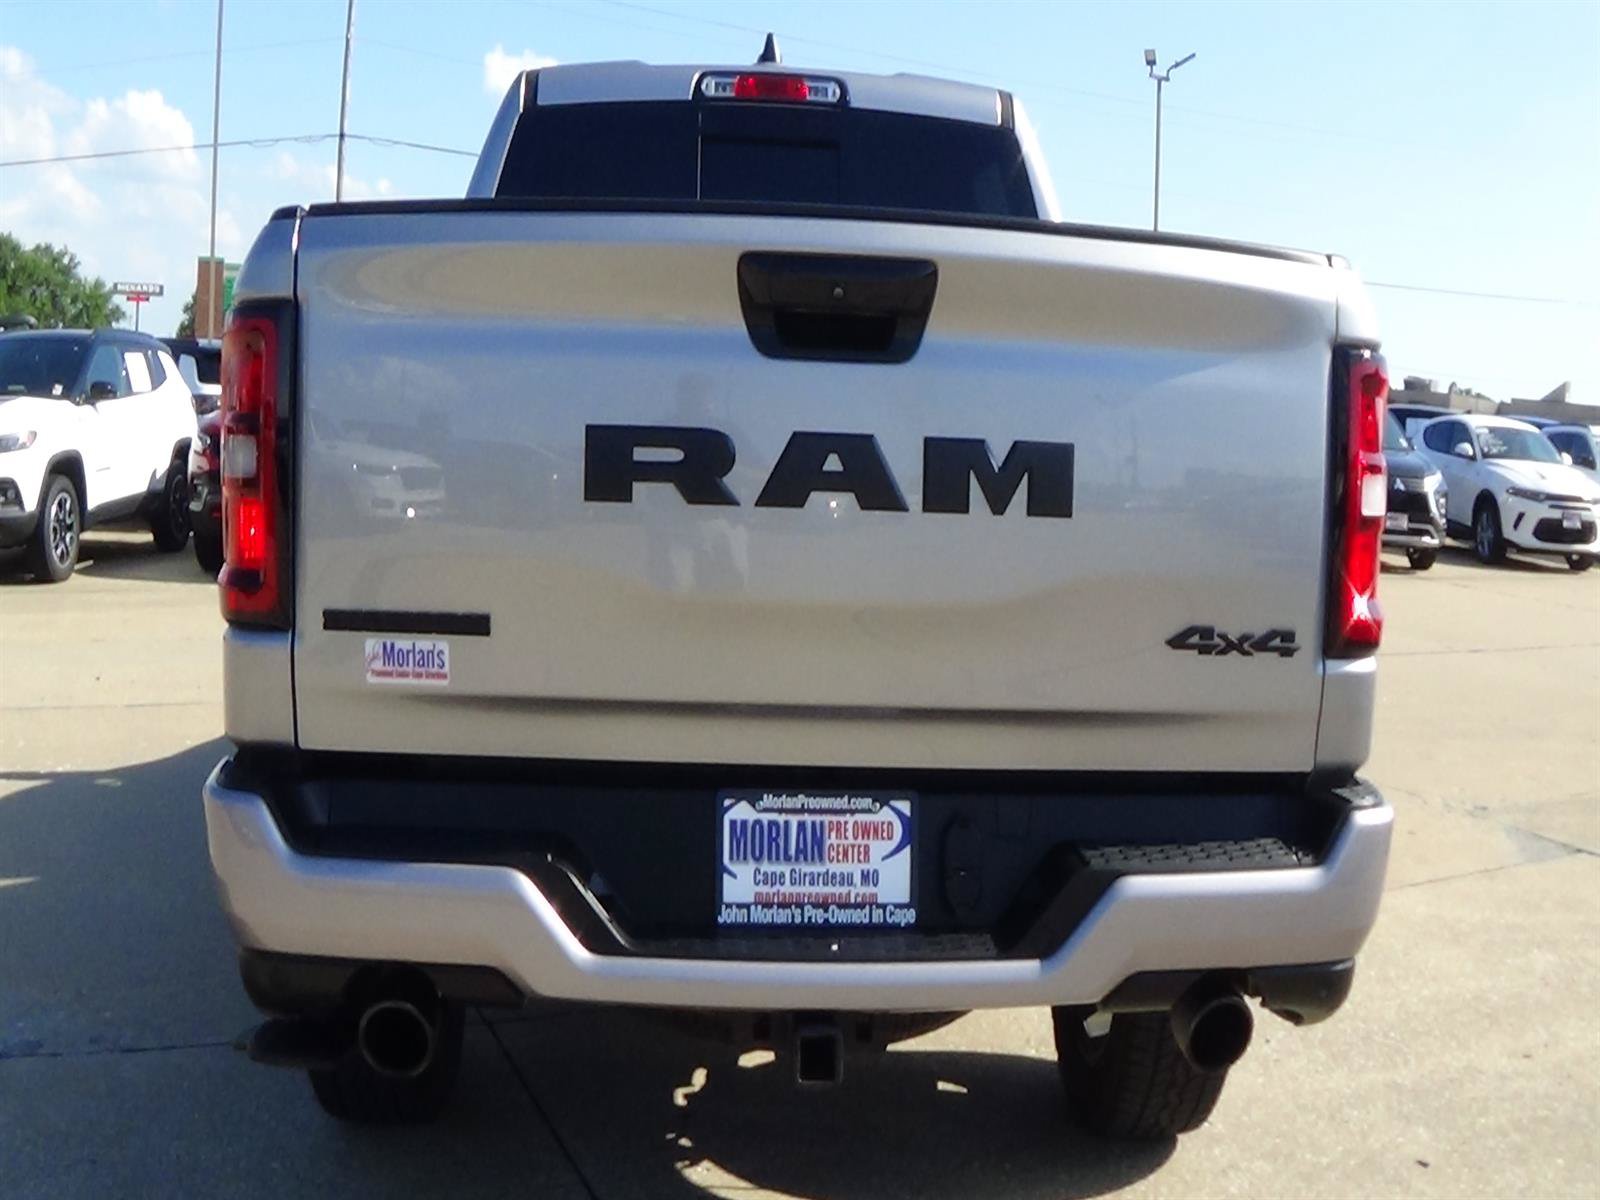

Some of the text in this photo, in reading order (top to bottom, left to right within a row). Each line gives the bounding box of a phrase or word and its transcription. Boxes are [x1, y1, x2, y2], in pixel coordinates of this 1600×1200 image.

[584, 424, 1075, 518] RAM
[1165, 625, 1300, 658] 4x4
[382, 641, 446, 670] Morlan's
[763, 794, 873, 810] MorlanPreowned.com
[729, 818, 825, 864] MORLAN
[827, 819, 894, 841] PRE OWNED
[827, 843, 870, 863] CENTER
[753, 867, 880, 888] Cape Girardeau, MO
[754, 890, 879, 904] morlanpreownedcom
[718, 904, 916, 926] John Morlan's Pre-Owned in Cape
